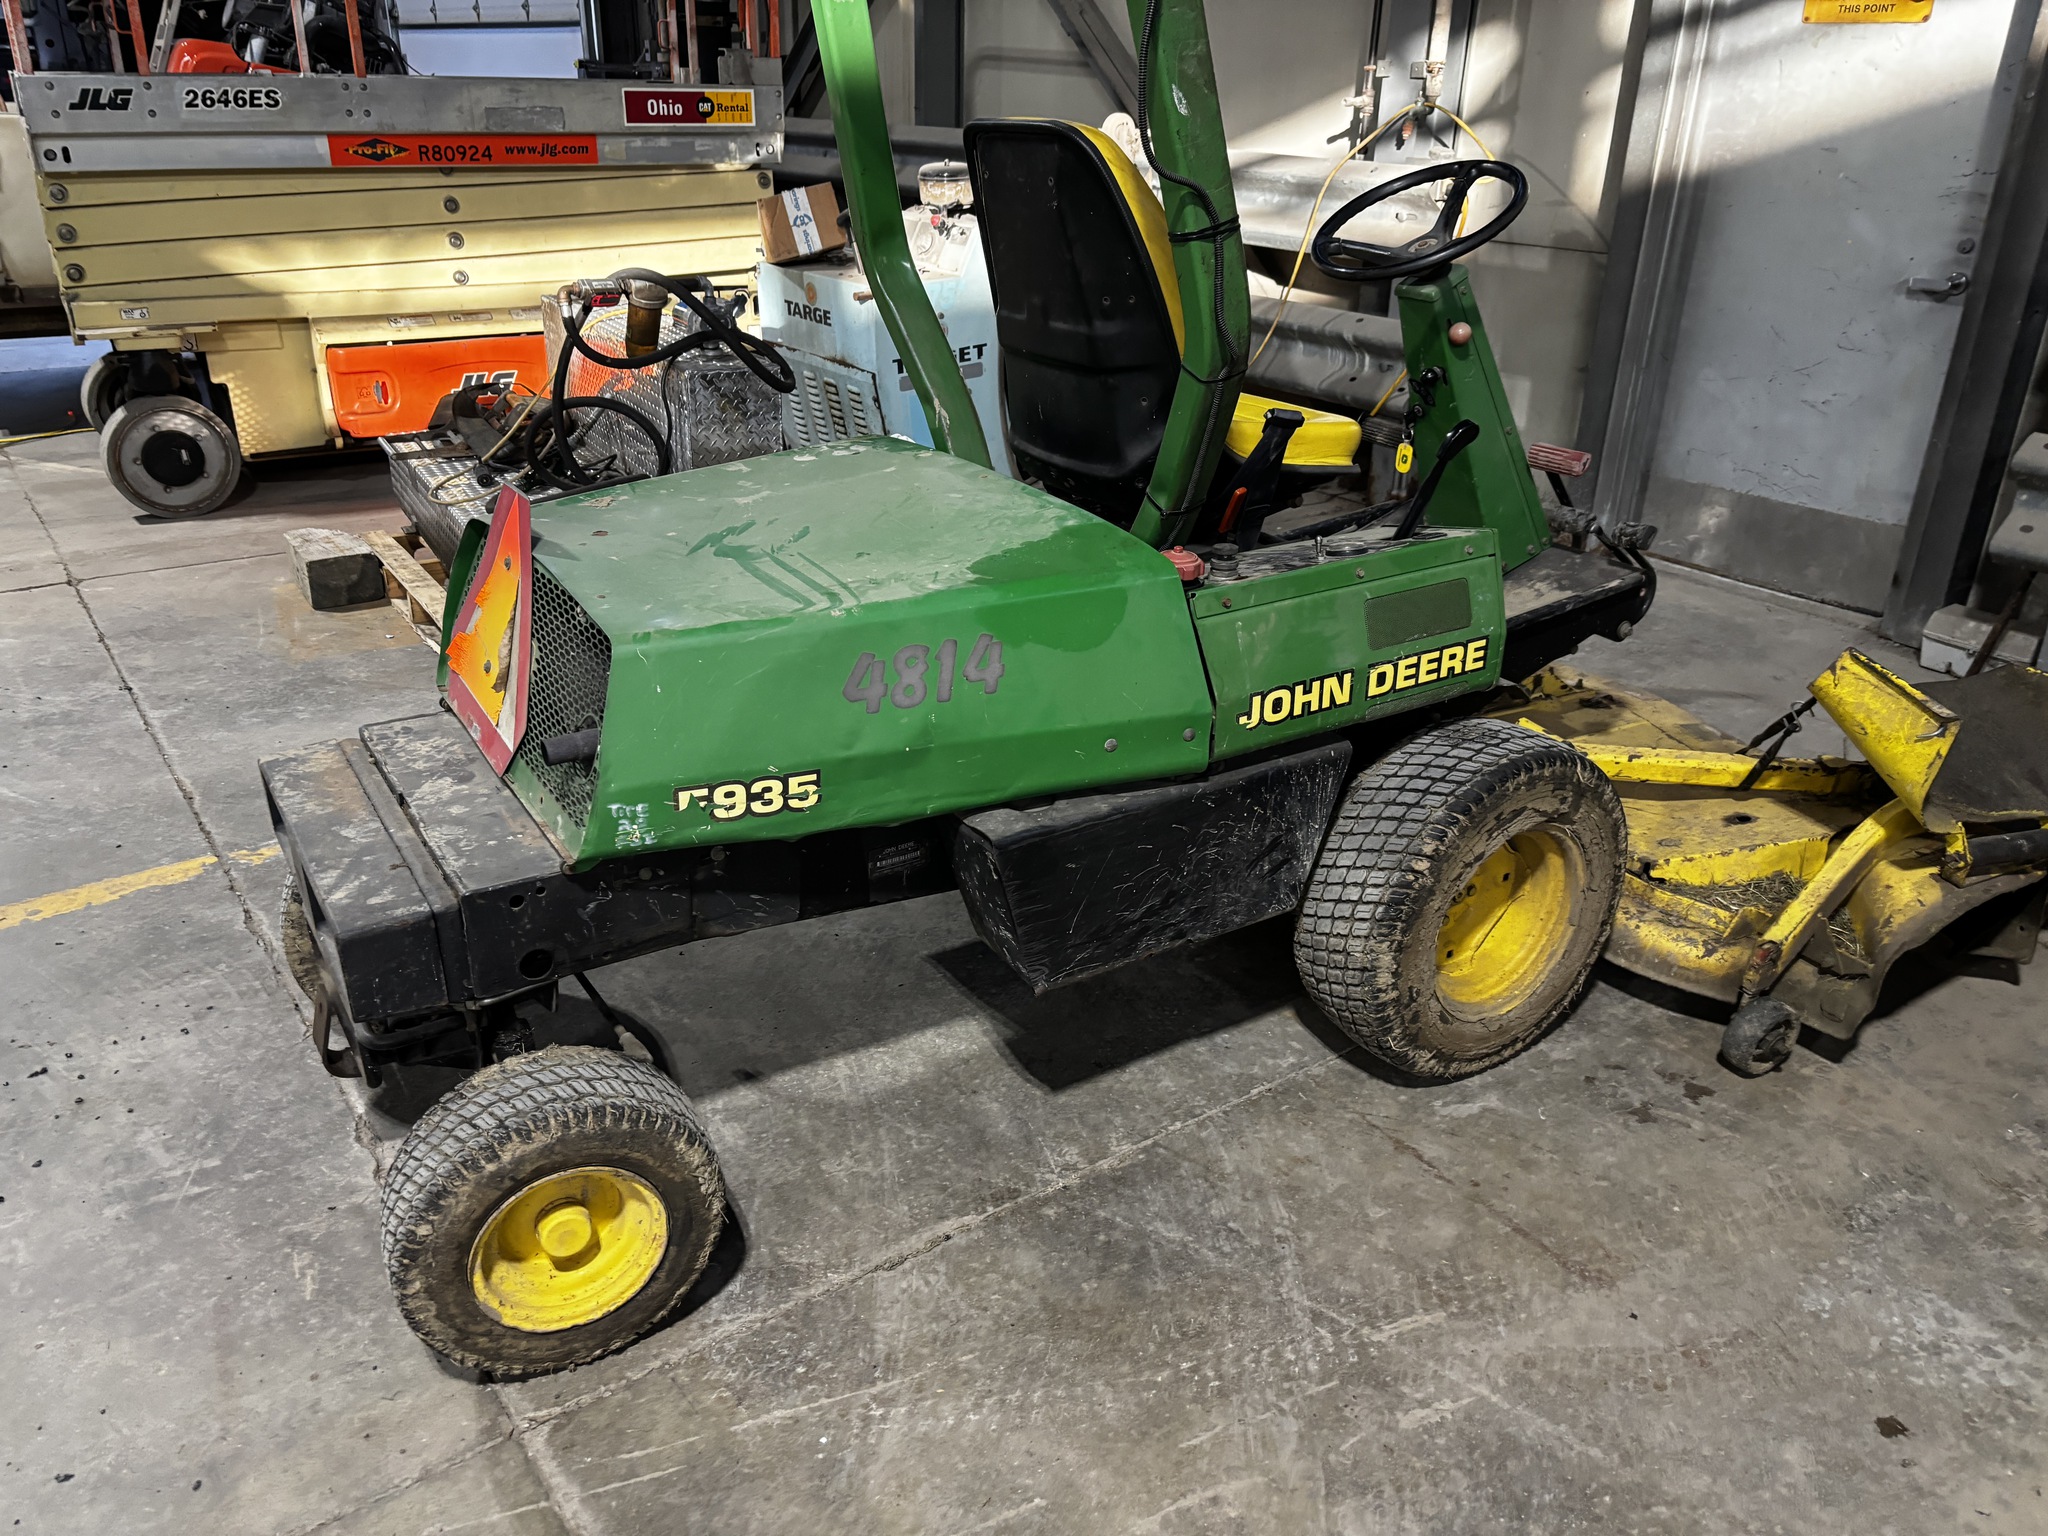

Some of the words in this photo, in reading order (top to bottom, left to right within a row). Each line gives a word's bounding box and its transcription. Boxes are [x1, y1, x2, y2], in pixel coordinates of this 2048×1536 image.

[1838, 4, 1861, 13] THIS
[1863, 3, 1896, 13] POINT
[68, 88, 133, 111] JLG
[184, 88, 282, 109] 2646ES
[647, 99, 683, 116] Ohio
[698, 102, 711, 113] CAT
[716, 103, 749, 113] Rental
[418, 144, 493, 162] R80924
[504, 143, 589, 157] www.jlg.com
[784, 299, 832, 327] TARGE
[892, 343, 988, 375] TET
[842, 633, 1005, 714] 4814
[1236, 668, 1354, 730] JOHN
[1366, 636, 1489, 701] DEERE
